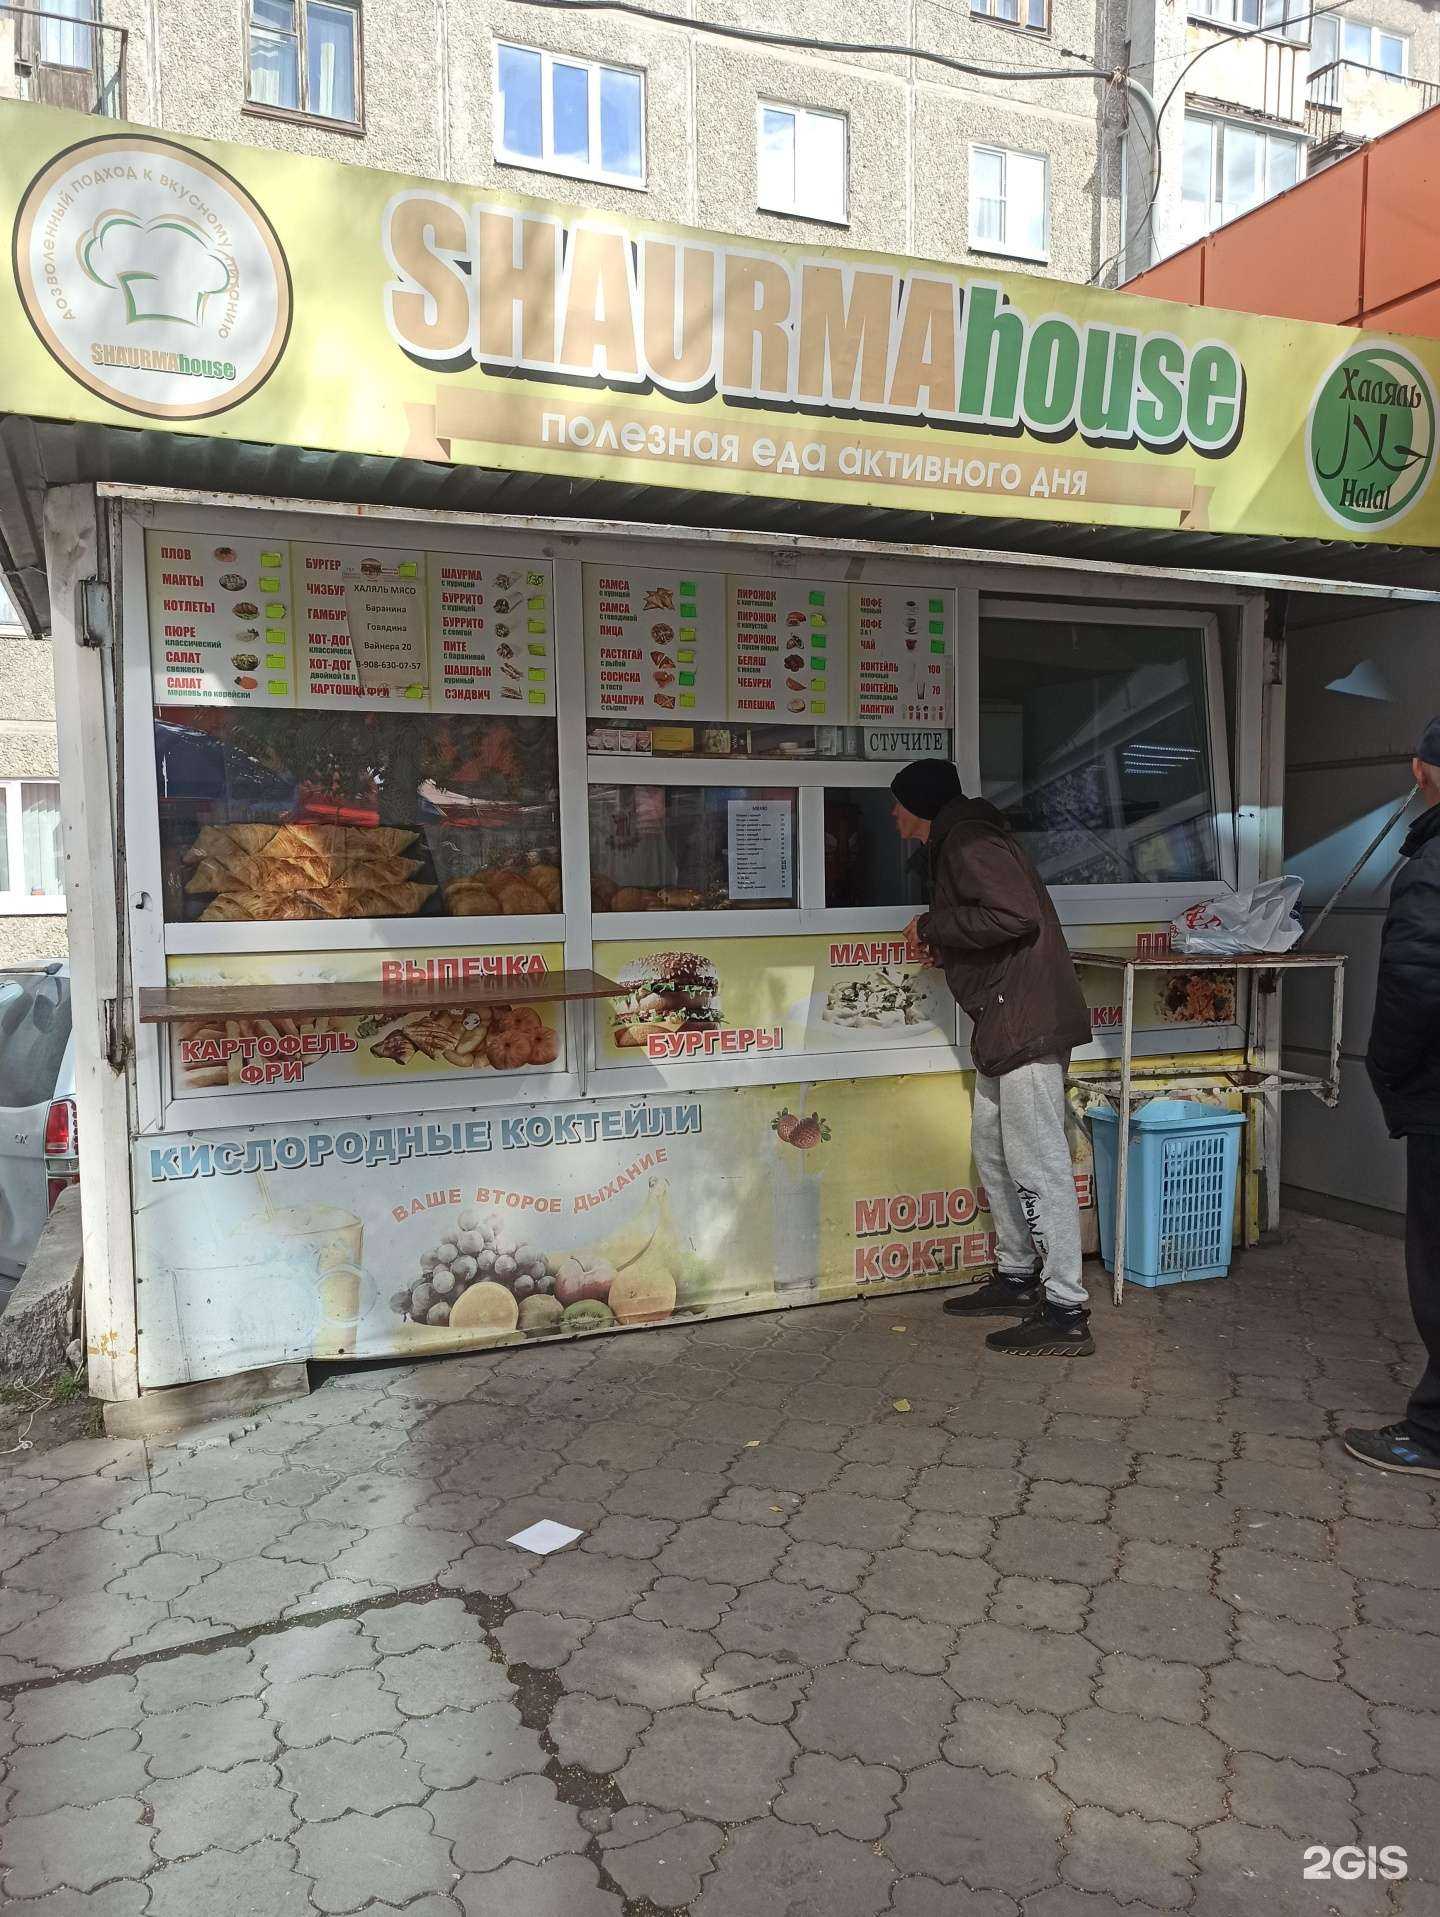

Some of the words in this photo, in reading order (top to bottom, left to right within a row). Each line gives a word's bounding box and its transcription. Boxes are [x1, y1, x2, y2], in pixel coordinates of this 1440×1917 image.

[384, 190, 1246, 458] SHAURMAhouse
[90, 342, 236, 382] SHAURMAhouse
[1339, 477, 1392, 511] Halal
[161, 547, 192, 560] ПЛОВ
[306, 558, 341, 571] БУРГЕР
[162, 574, 204, 587] МАНТЫ
[441, 568, 482, 581] ШАУРМА
[307, 584, 345, 596] ЧИЗБУР
[600, 579, 629, 591] САМСА
[442, 593, 484, 605] БУРРИТО
[737, 589, 776, 601] ПИРОЖОК
[164, 600, 216, 613] КОТЛЕТЫ
[600, 602, 630, 613] САМСА
[860, 597, 882, 608] КОФЕ
[308, 608, 346, 621] ГАМБУР
[365, 604, 406, 614] Баранина
[442, 617, 484, 629] БУРРИТО
[737, 611, 776, 623] ПИРОЖОК
[367, 623, 407, 632] Говядина
[860, 619, 882, 629] КОФЕ
[165, 626, 196, 638] ПЮРЕ
[737, 633, 776, 645] ПИРОЖОК
[860, 639, 875, 650] ЧАЙ
[443, 641, 467, 651] ПИТЕ
[166, 652, 201, 664] САЛАТ
[737, 656, 766, 666] БЕЛЯШ
[444, 665, 491, 677] ШАШЛЫК
[860, 661, 899, 672] КОКТЕЙЛЬ
[928, 664, 940, 674] 100
[167, 677, 202, 689] САЛАТ
[601, 671, 640, 683] СОСИСКА
[737, 678, 771, 689] ЧЕБУРЕК
[860, 682, 899, 693] КОКТЕЙЛЬ
[932, 685, 940, 694] 70
[445, 688, 491, 701] СЭНДВИЧ
[601, 694, 644, 705] ХАЧАПУРИ
[737, 700, 776, 711] ЛЕПЕШКА
[860, 705, 894, 714] НАПИТКИ
[870, 733, 943, 751] СТУЧИТЕ
[380, 954, 548, 984] ВЫПЕЧКА
[180, 1032, 358, 1062] КАРТОФЕЛЬ
[646, 1026, 784, 1058] БУРГЕРЫ
[240, 1061, 304, 1085] ФРИ
[149, 1120, 492, 1183] КИСЛОРОДНЫЕ
[500, 1103, 702, 1150] КОКТЕЙЛИ
[391, 1188, 463, 1224] ВАШЕ
[475, 1188, 562, 1213] ВТОРОЕ
[572, 1148, 669, 1215] ДЫХАНИЕ
[854, 1173, 1093, 1238] МОЛОЕ
[854, 1232, 998, 1285] КОКТЕ
